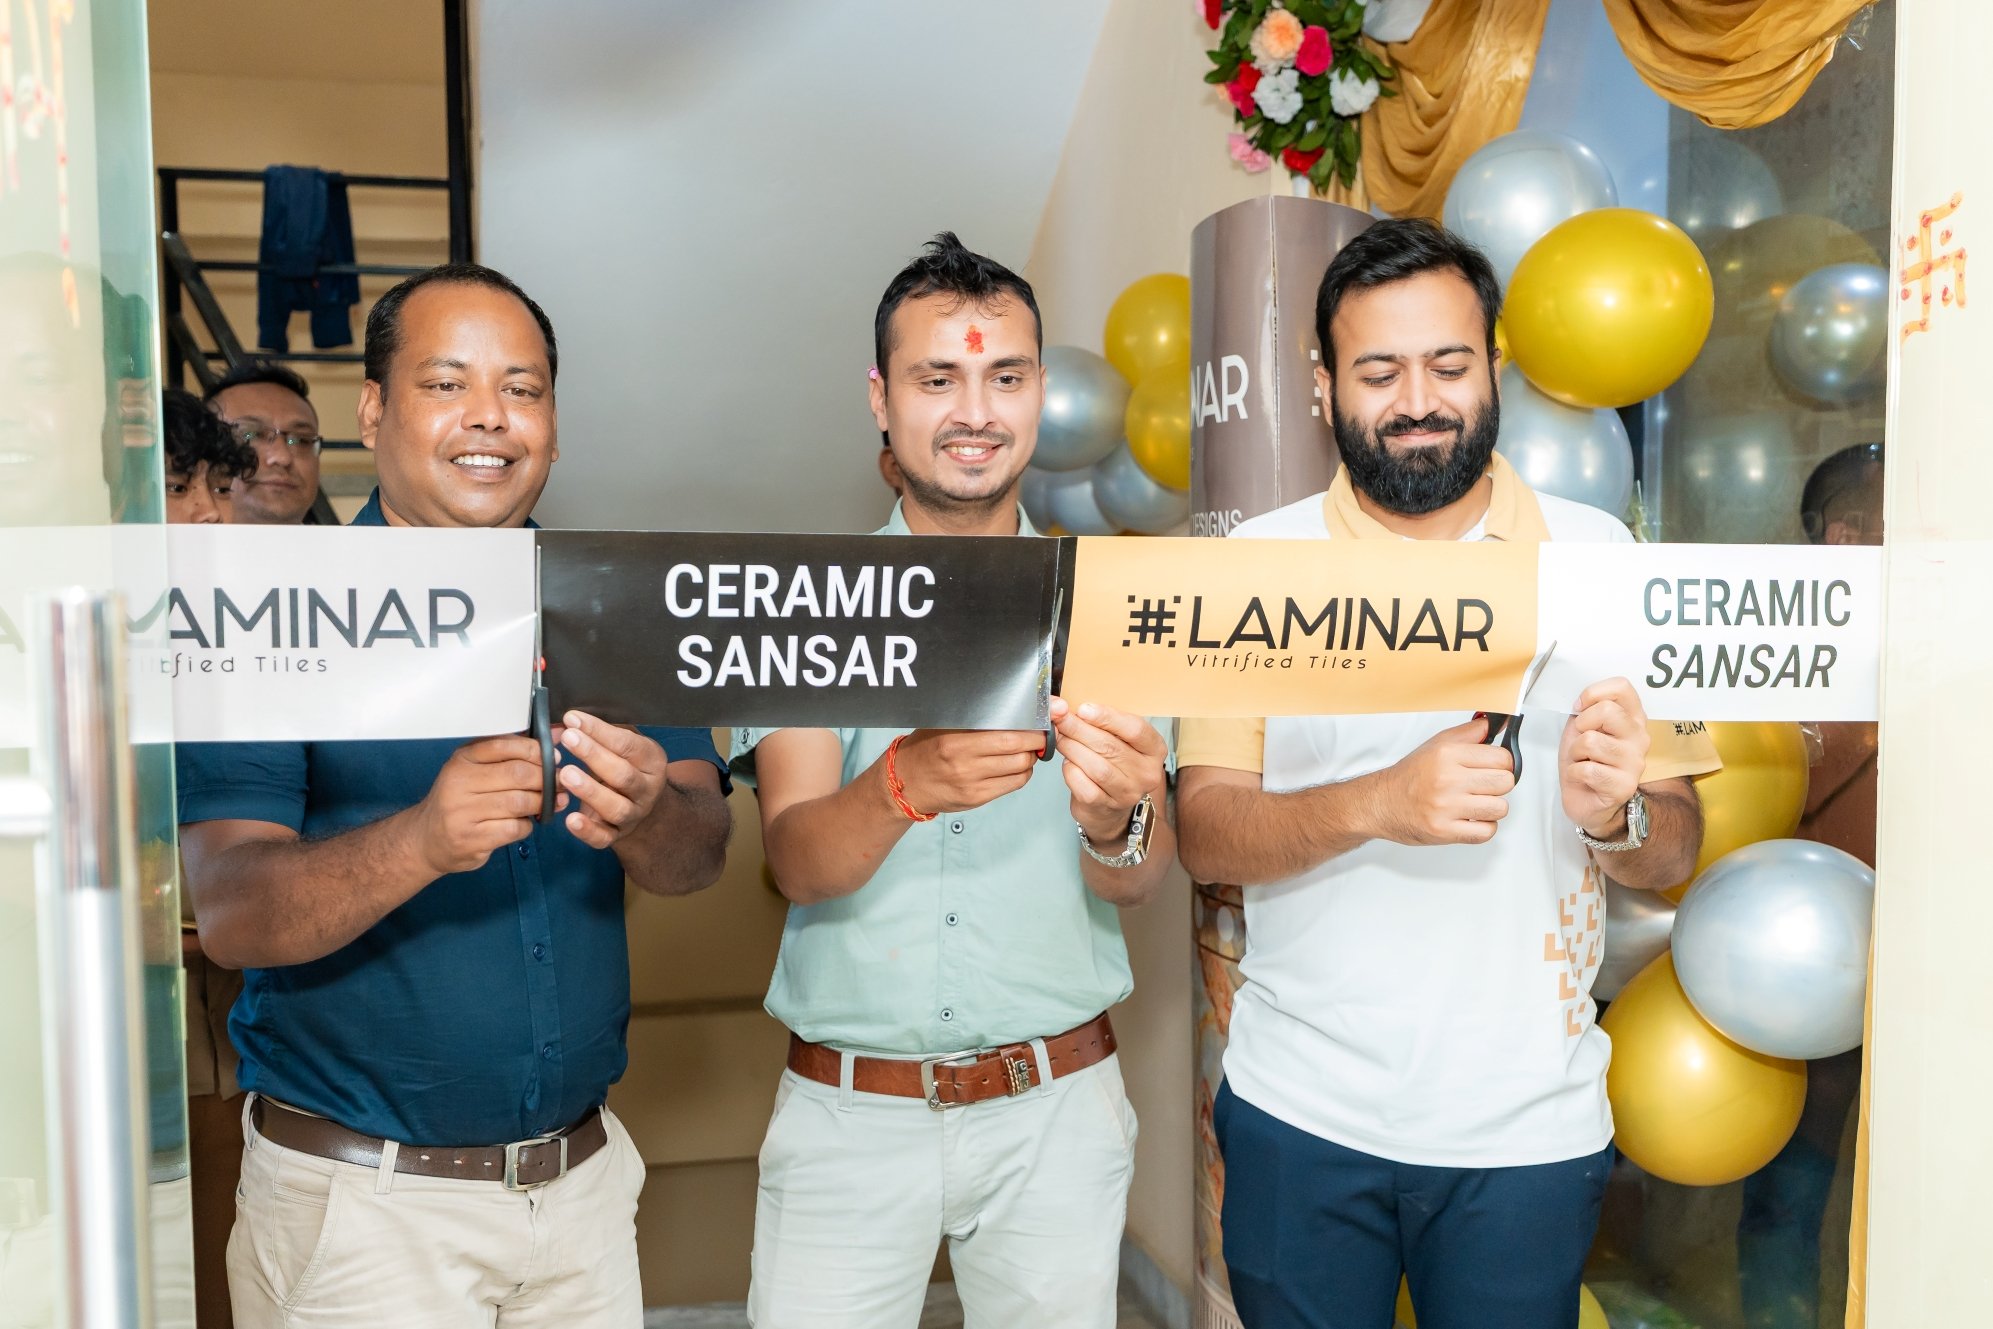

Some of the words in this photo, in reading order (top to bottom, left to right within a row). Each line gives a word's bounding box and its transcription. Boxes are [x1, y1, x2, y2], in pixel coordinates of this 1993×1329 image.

[664, 563, 936, 619] CERAMIC
[1643, 577, 1851, 627] CERAMIC
[254, 655, 327, 673] Tiles
[676, 634, 918, 687] SANSAR
[1186, 651, 1293, 672] Vitrified
[1309, 655, 1367, 670] Tiles
[1645, 643, 1838, 688] SANSAR
